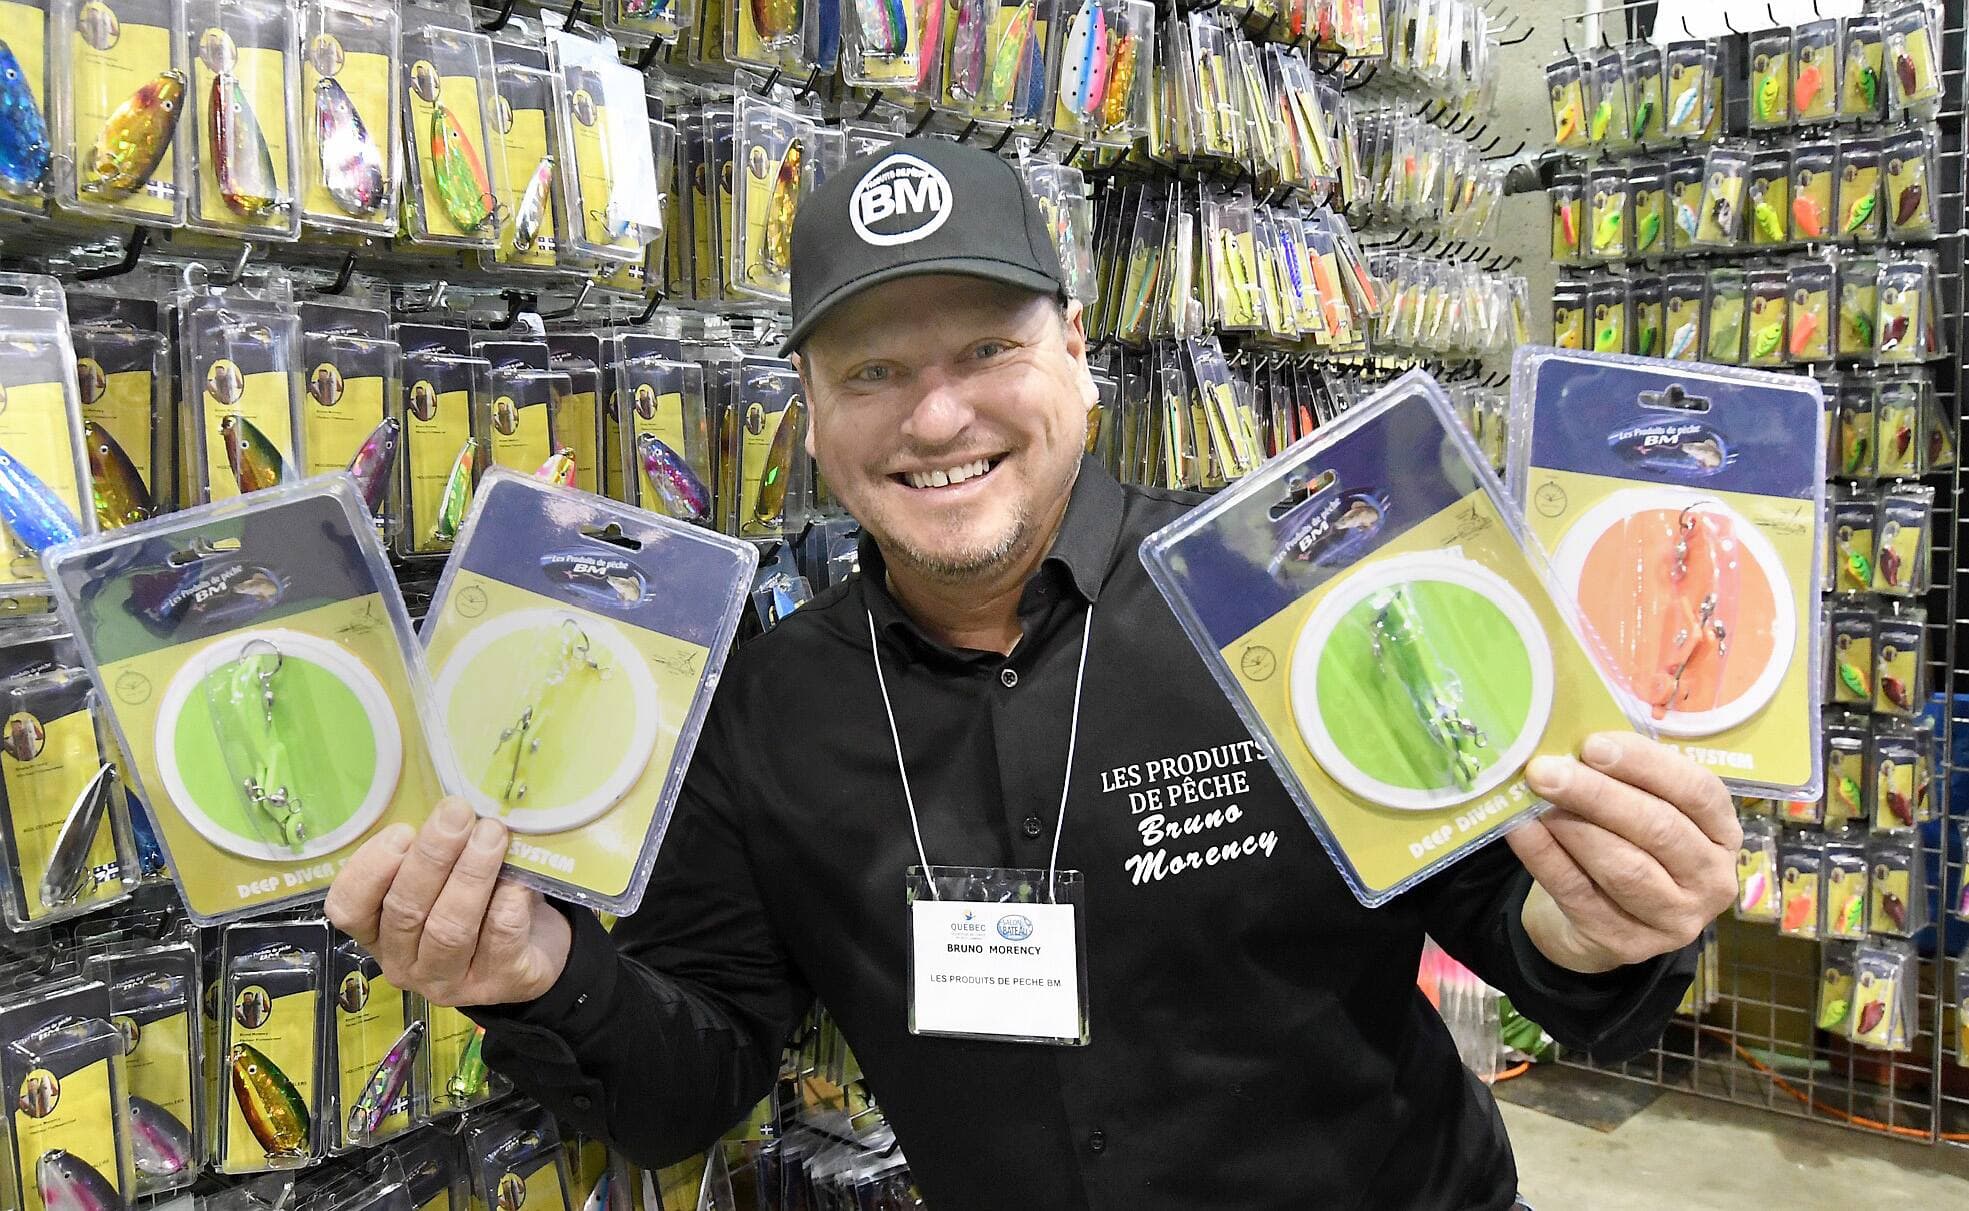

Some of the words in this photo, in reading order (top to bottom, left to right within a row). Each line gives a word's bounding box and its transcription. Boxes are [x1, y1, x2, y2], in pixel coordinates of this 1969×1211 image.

[861, 178, 941, 225] BM
[1644, 435, 1679, 446] BM
[1299, 521, 1329, 551] BM
[573, 563, 606, 575] BM
[596, 558, 606, 566] de
[195, 582, 227, 602] BM
[1100, 764, 1142, 793] LES
[1145, 739, 1269, 783] PRODUITS
[1128, 788, 1163, 815] DE
[1166, 771, 1250, 808] PÊCHE
[1137, 803, 1243, 847] Bruno
[1408, 824, 1453, 859] DEEP
[1455, 795, 1510, 832] DIVER
[1124, 830, 1279, 887] Morency
[236, 876, 280, 899] DEEP
[283, 862, 335, 887] DIVER
[1002, 926, 1028, 936] BATEAU
[947, 943, 983, 954] BRUNO
[989, 945, 1041, 955] MORENCY
[930, 973, 947, 983] LES
[949, 975, 995, 985] PRODUITS
[998, 977, 1010, 985] DE
[1013, 977, 1044, 986] PECHE
[1047, 979, 1062, 987] BM
